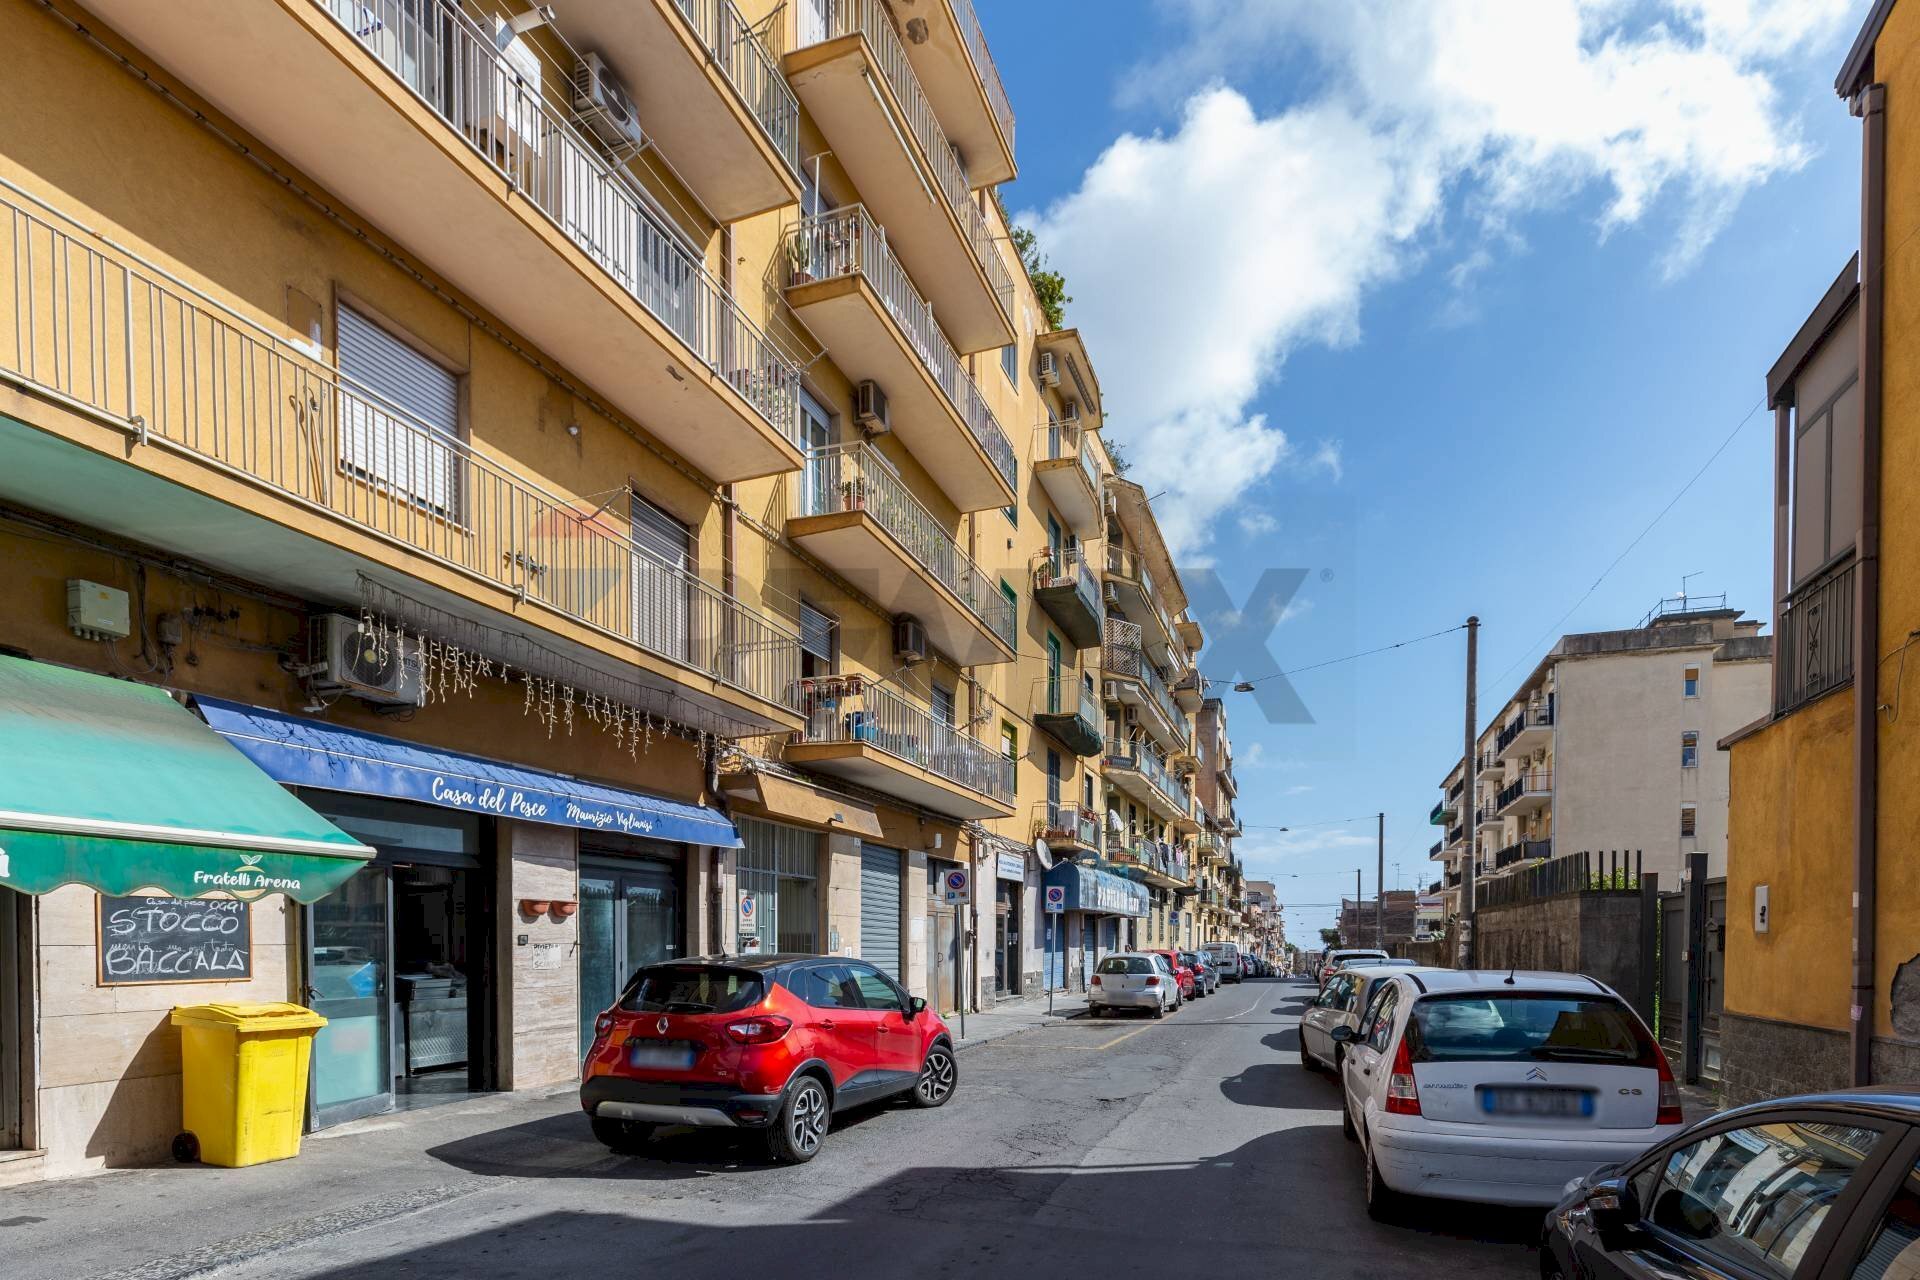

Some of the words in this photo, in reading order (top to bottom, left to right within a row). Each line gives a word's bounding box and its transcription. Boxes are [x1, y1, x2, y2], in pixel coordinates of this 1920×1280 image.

[432, 777, 475, 805] Casa
[478, 788, 506, 812] del
[510, 792, 547, 817] Pesce
[566, 802, 614, 827] Maurizio
[194, 870, 251, 886] Fratelli
[254, 875, 301, 889] Arena
[109, 909, 239, 934] STOCCO
[1618, 1088, 1642, 1096] C3
